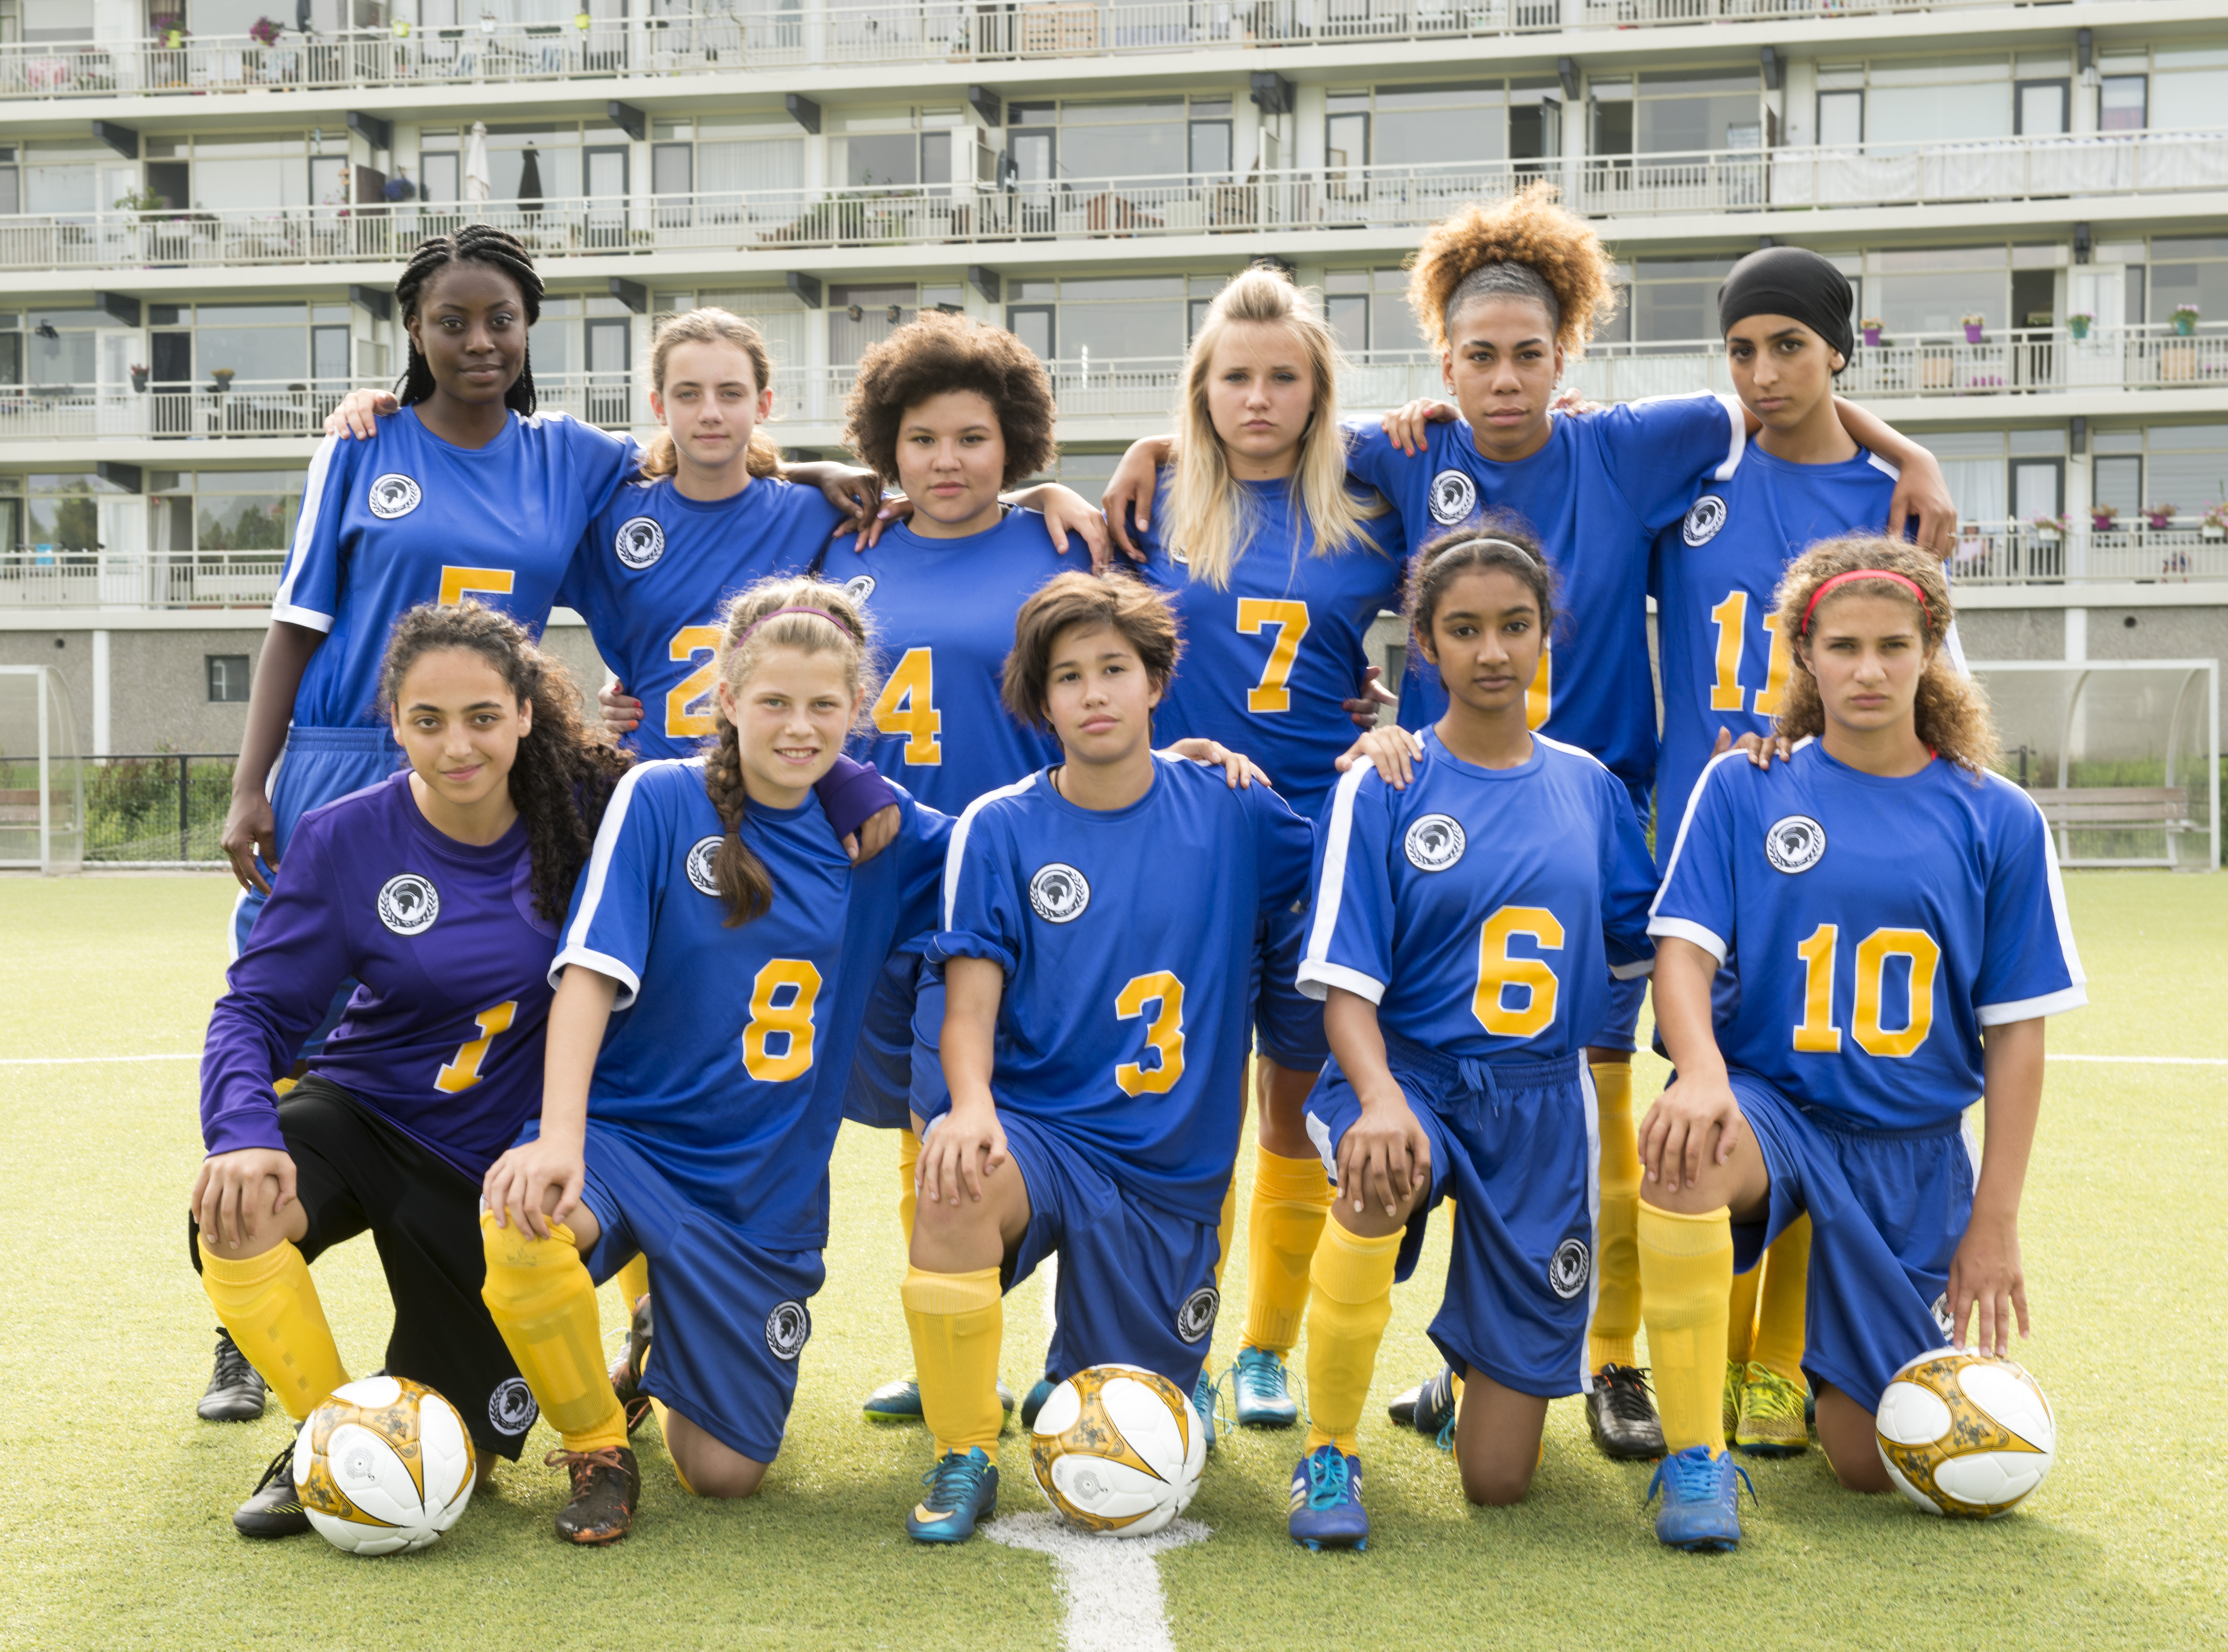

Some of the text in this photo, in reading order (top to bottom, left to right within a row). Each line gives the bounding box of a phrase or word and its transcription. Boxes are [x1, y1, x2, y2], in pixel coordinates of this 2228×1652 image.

[665, 626, 720, 738] 2
[870, 647, 942, 766] 4
[1236, 597, 1310, 713] 7
[1710, 590, 1792, 716] 11
[742, 958, 822, 1082] 8
[1115, 969, 1185, 1098] 3
[1471, 905, 1565, 1038] 6
[1792, 923, 1941, 1058] 10
[433, 1000, 518, 1094] 1
